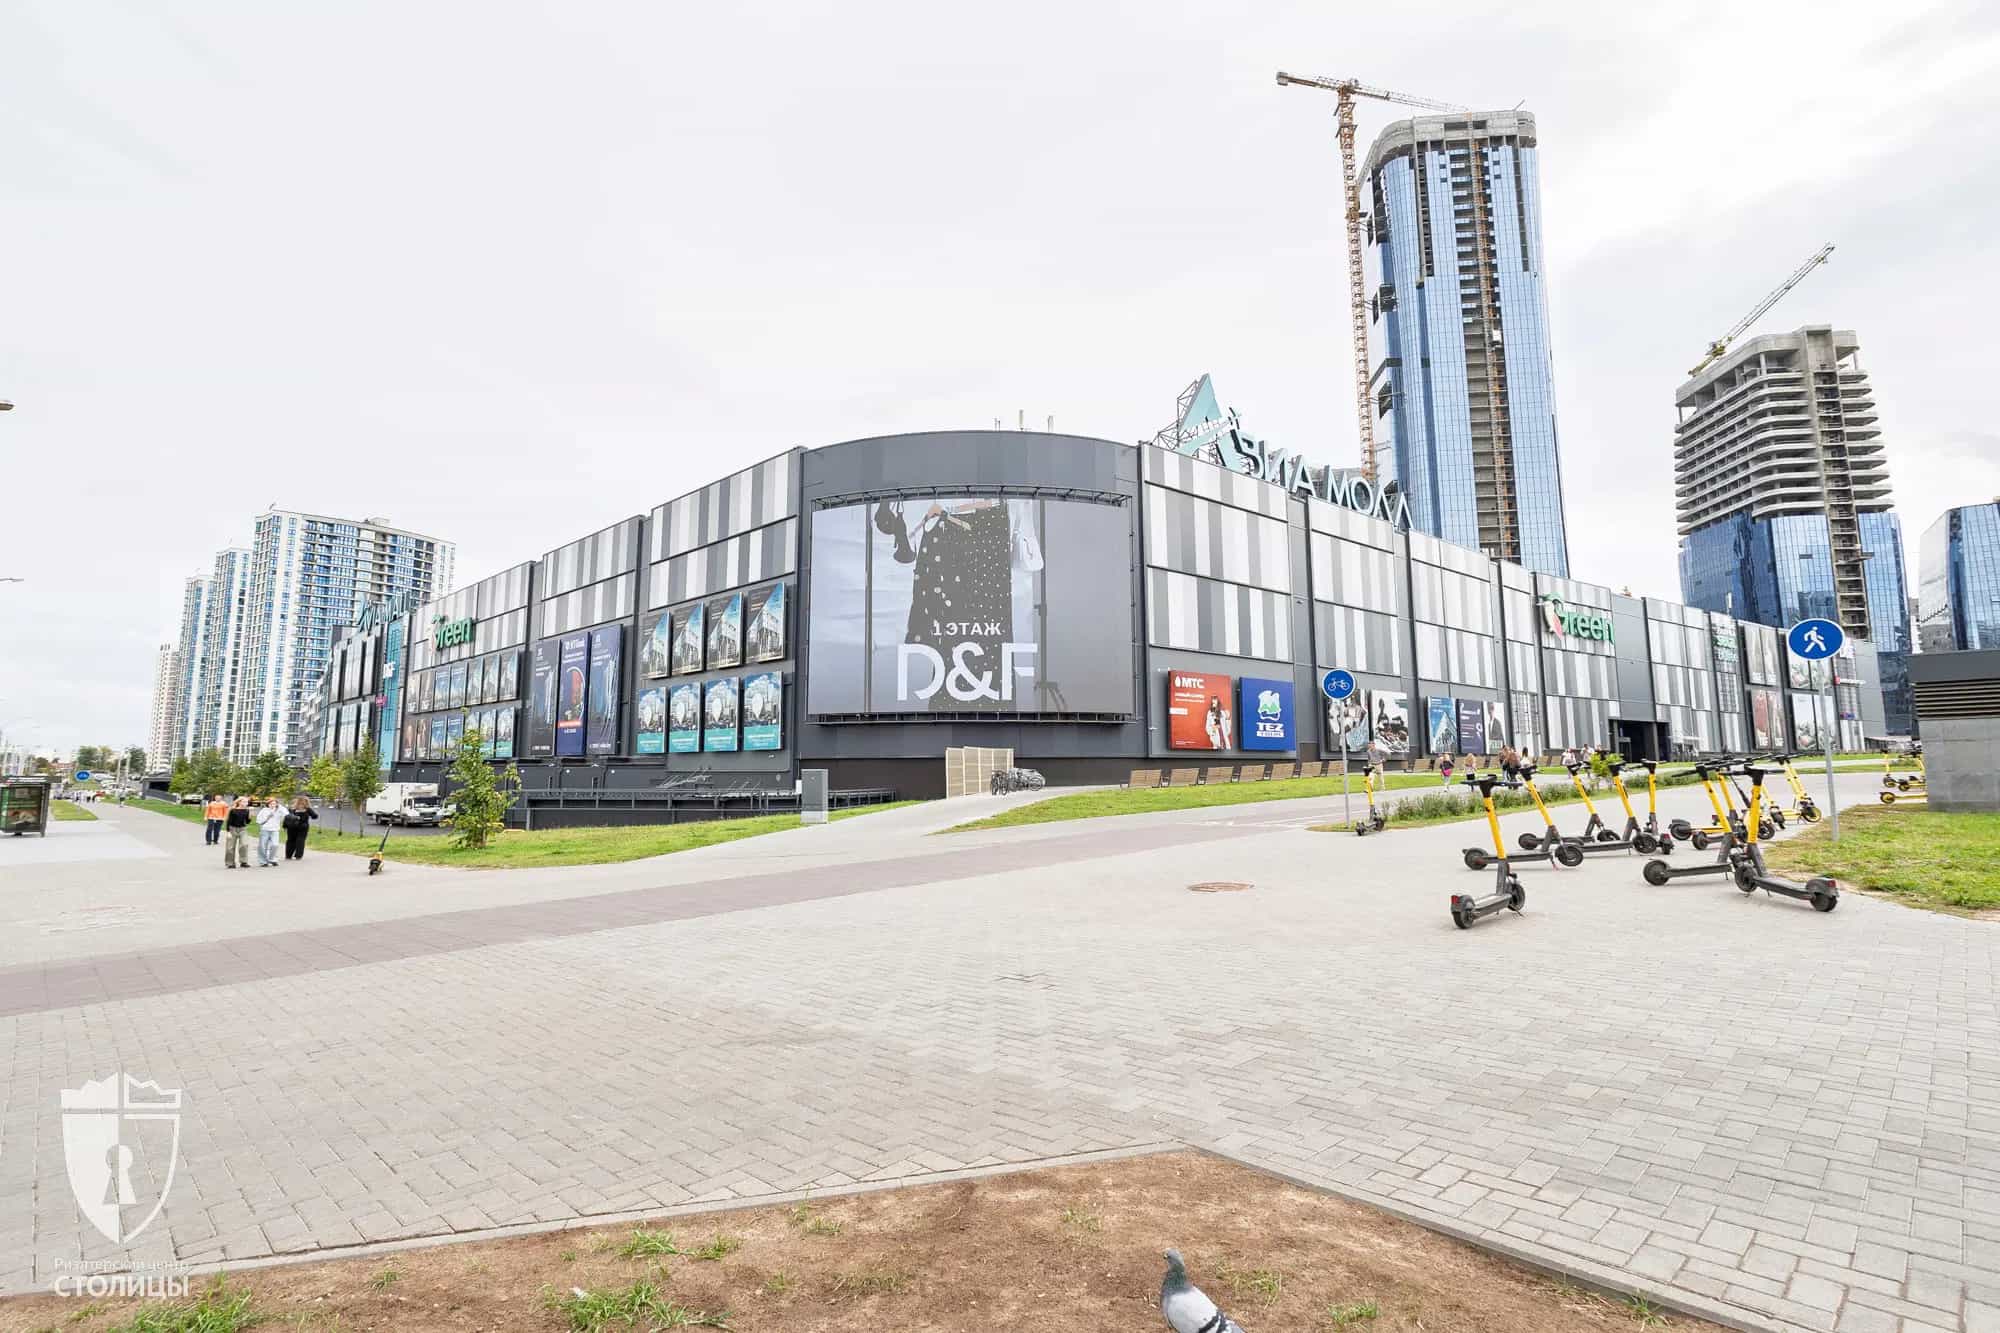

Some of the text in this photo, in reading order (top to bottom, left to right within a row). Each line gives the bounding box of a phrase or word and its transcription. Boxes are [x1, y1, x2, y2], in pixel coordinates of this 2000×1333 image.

[1323, 464, 1414, 529] МОЛЛ
[429, 616, 474, 652] Green
[932, 621, 1002, 636] 1 ЭТАЖ
[1540, 593, 1616, 645] Green
[897, 641, 1038, 702] D&F
[1181, 676, 1205, 689] МТС
[1256, 721, 1284, 732] TEZ
